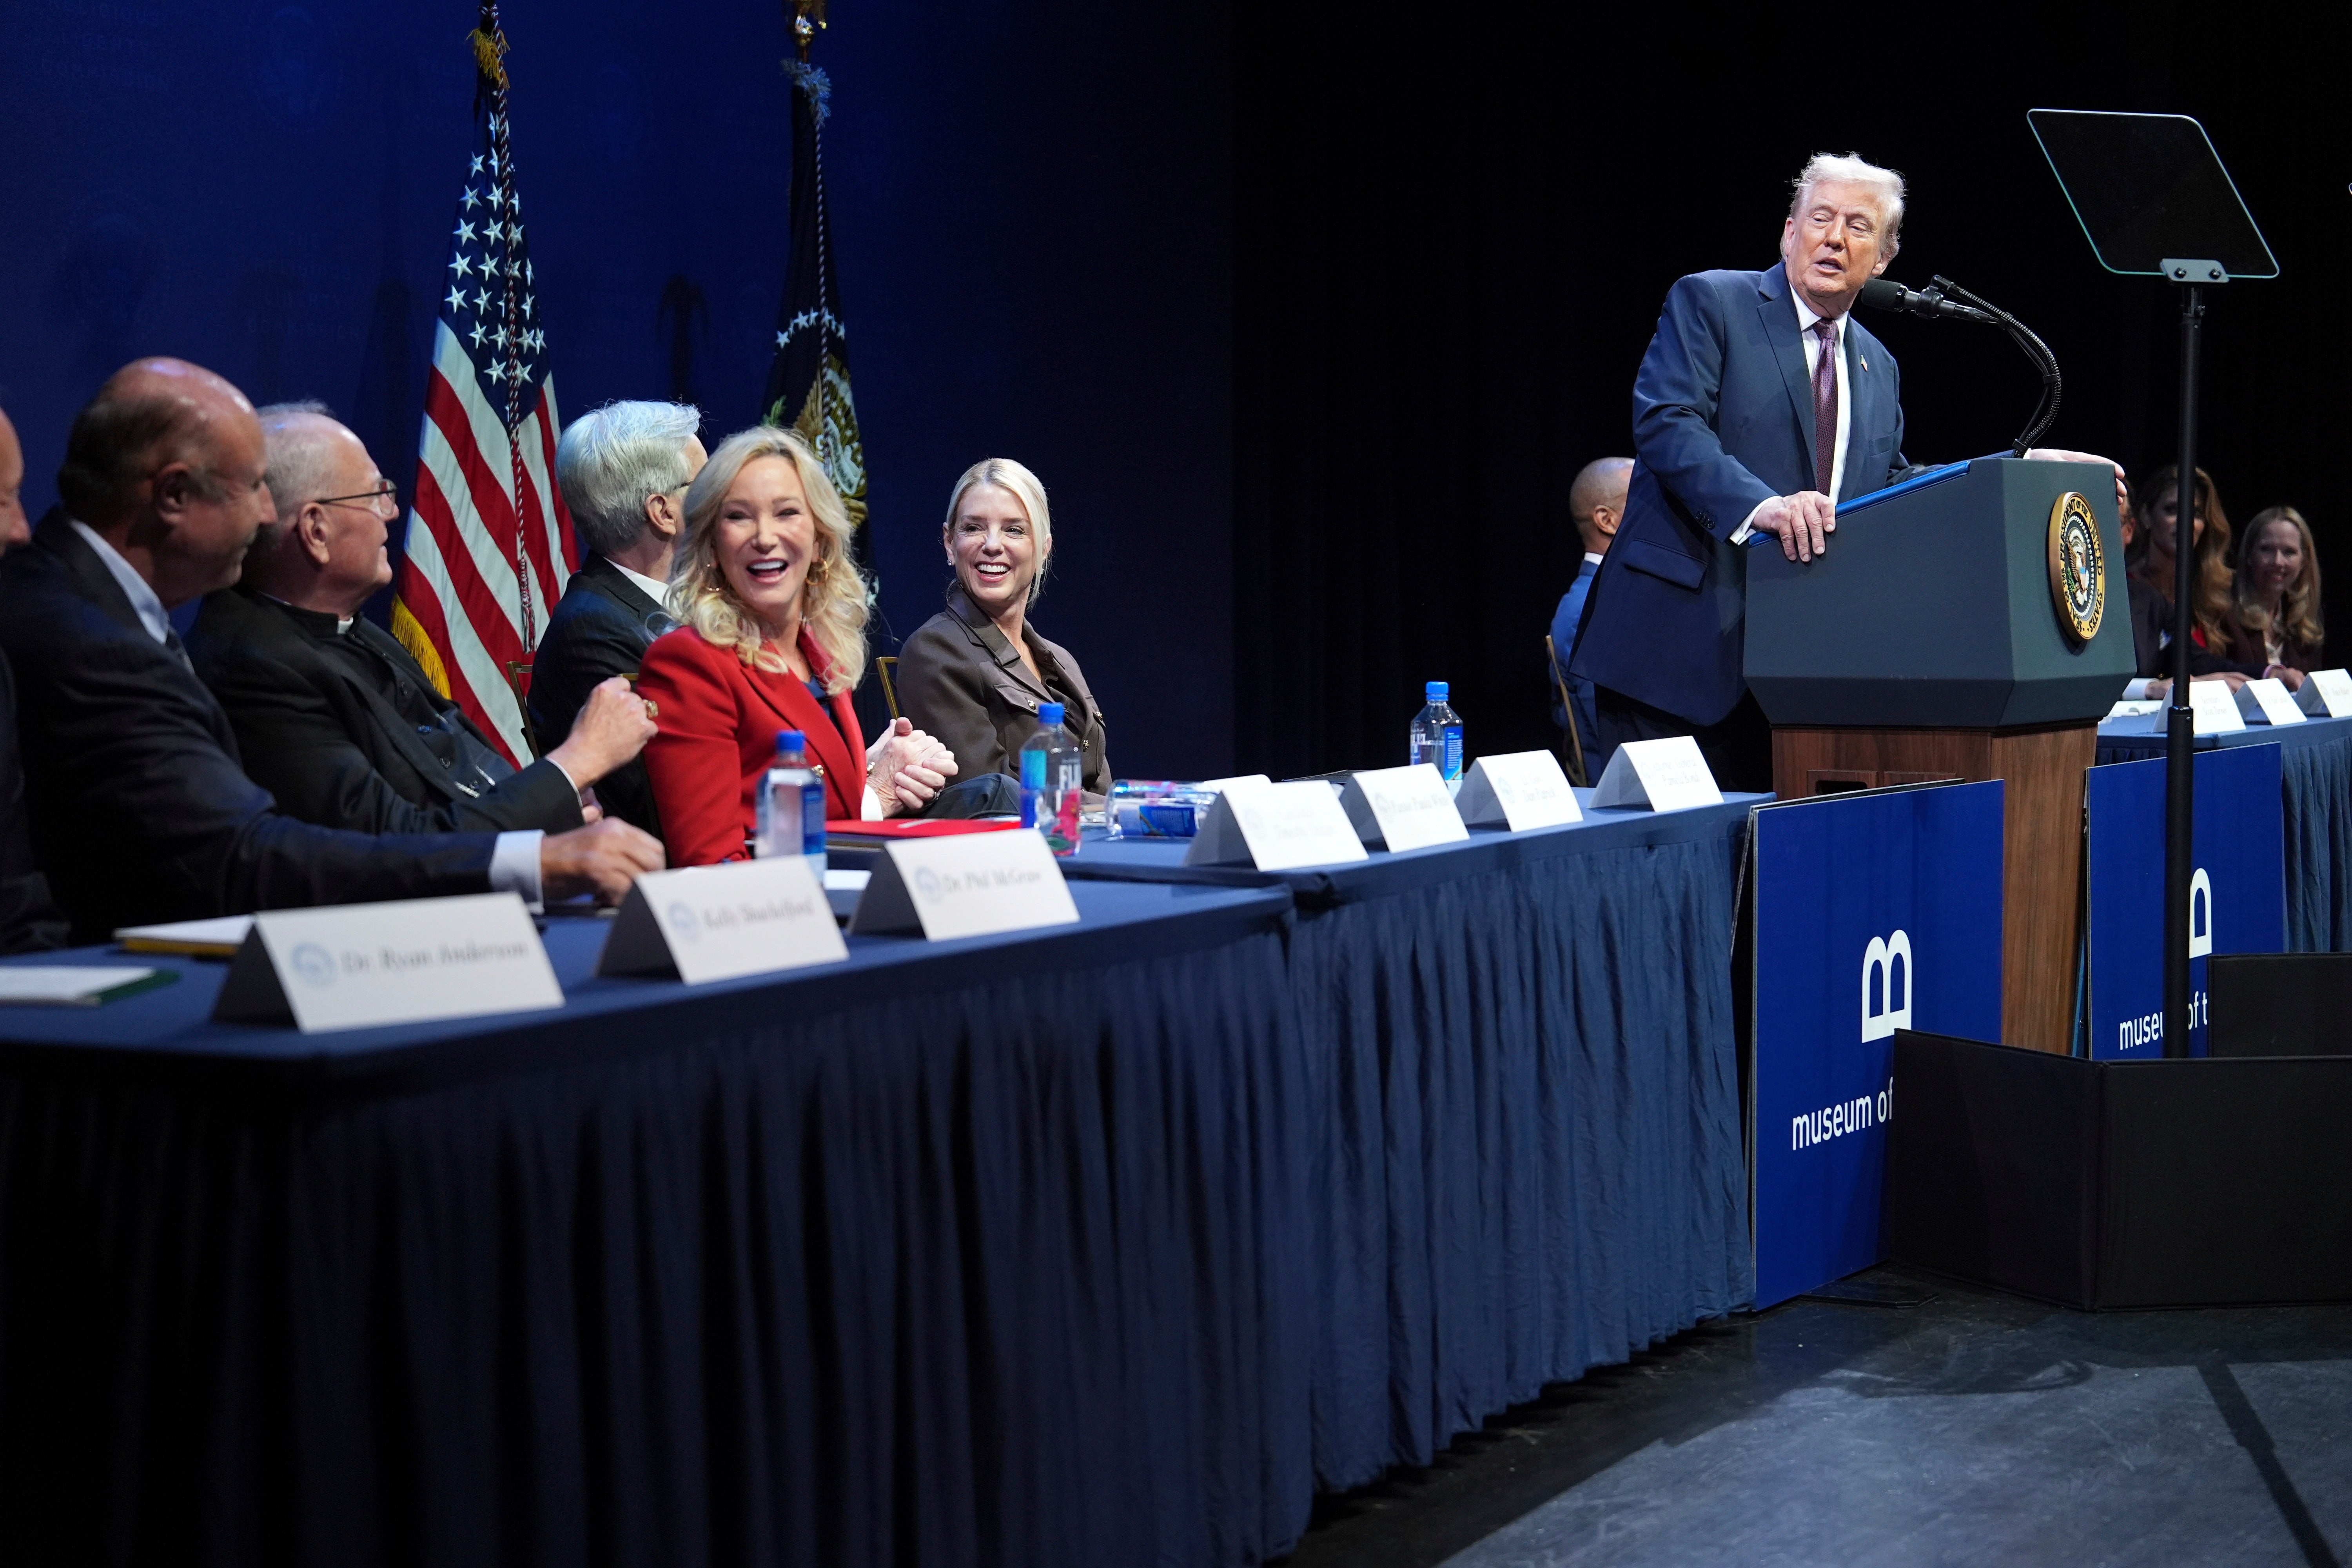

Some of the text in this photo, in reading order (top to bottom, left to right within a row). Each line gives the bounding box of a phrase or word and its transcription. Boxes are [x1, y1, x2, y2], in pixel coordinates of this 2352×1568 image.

[2089, 516, 2102, 575] UNITED
[2089, 589, 2102, 632] STATES
[2213, 706, 2227, 715] Turner
[1862, 929, 1912, 1043] B
[2120, 1011, 2163, 1051] muse
[1793, 1076, 1893, 1151] museum of
